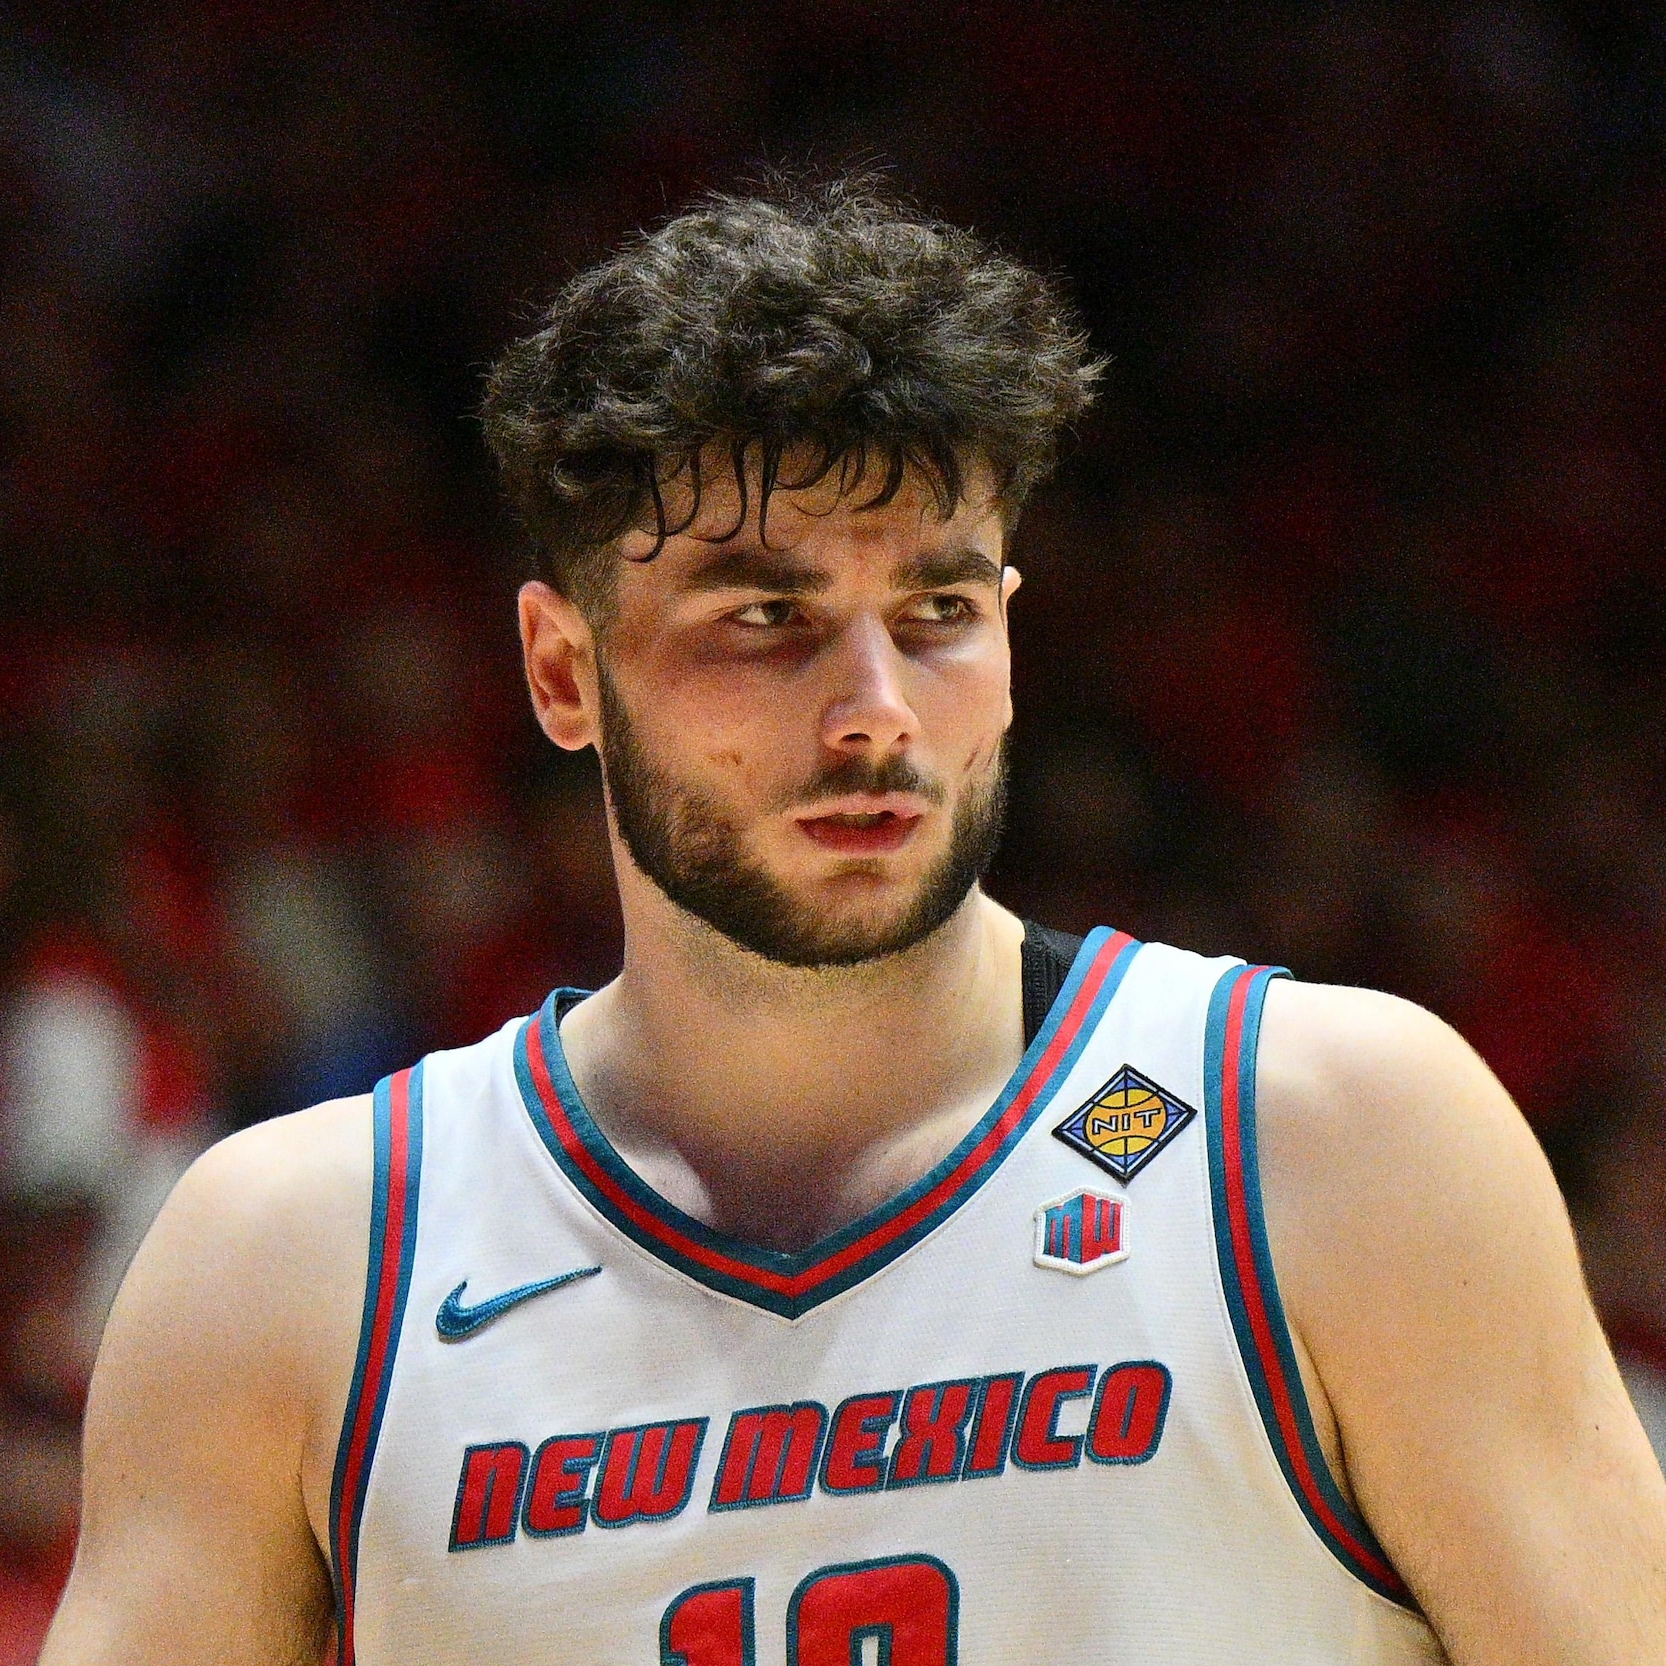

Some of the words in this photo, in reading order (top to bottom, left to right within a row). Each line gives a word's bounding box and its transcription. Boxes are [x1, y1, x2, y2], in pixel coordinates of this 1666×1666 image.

[1092, 1108, 1161, 1135] NIT
[448, 1416, 710, 1553] NEW
[708, 1360, 1173, 1513] MEXICO
